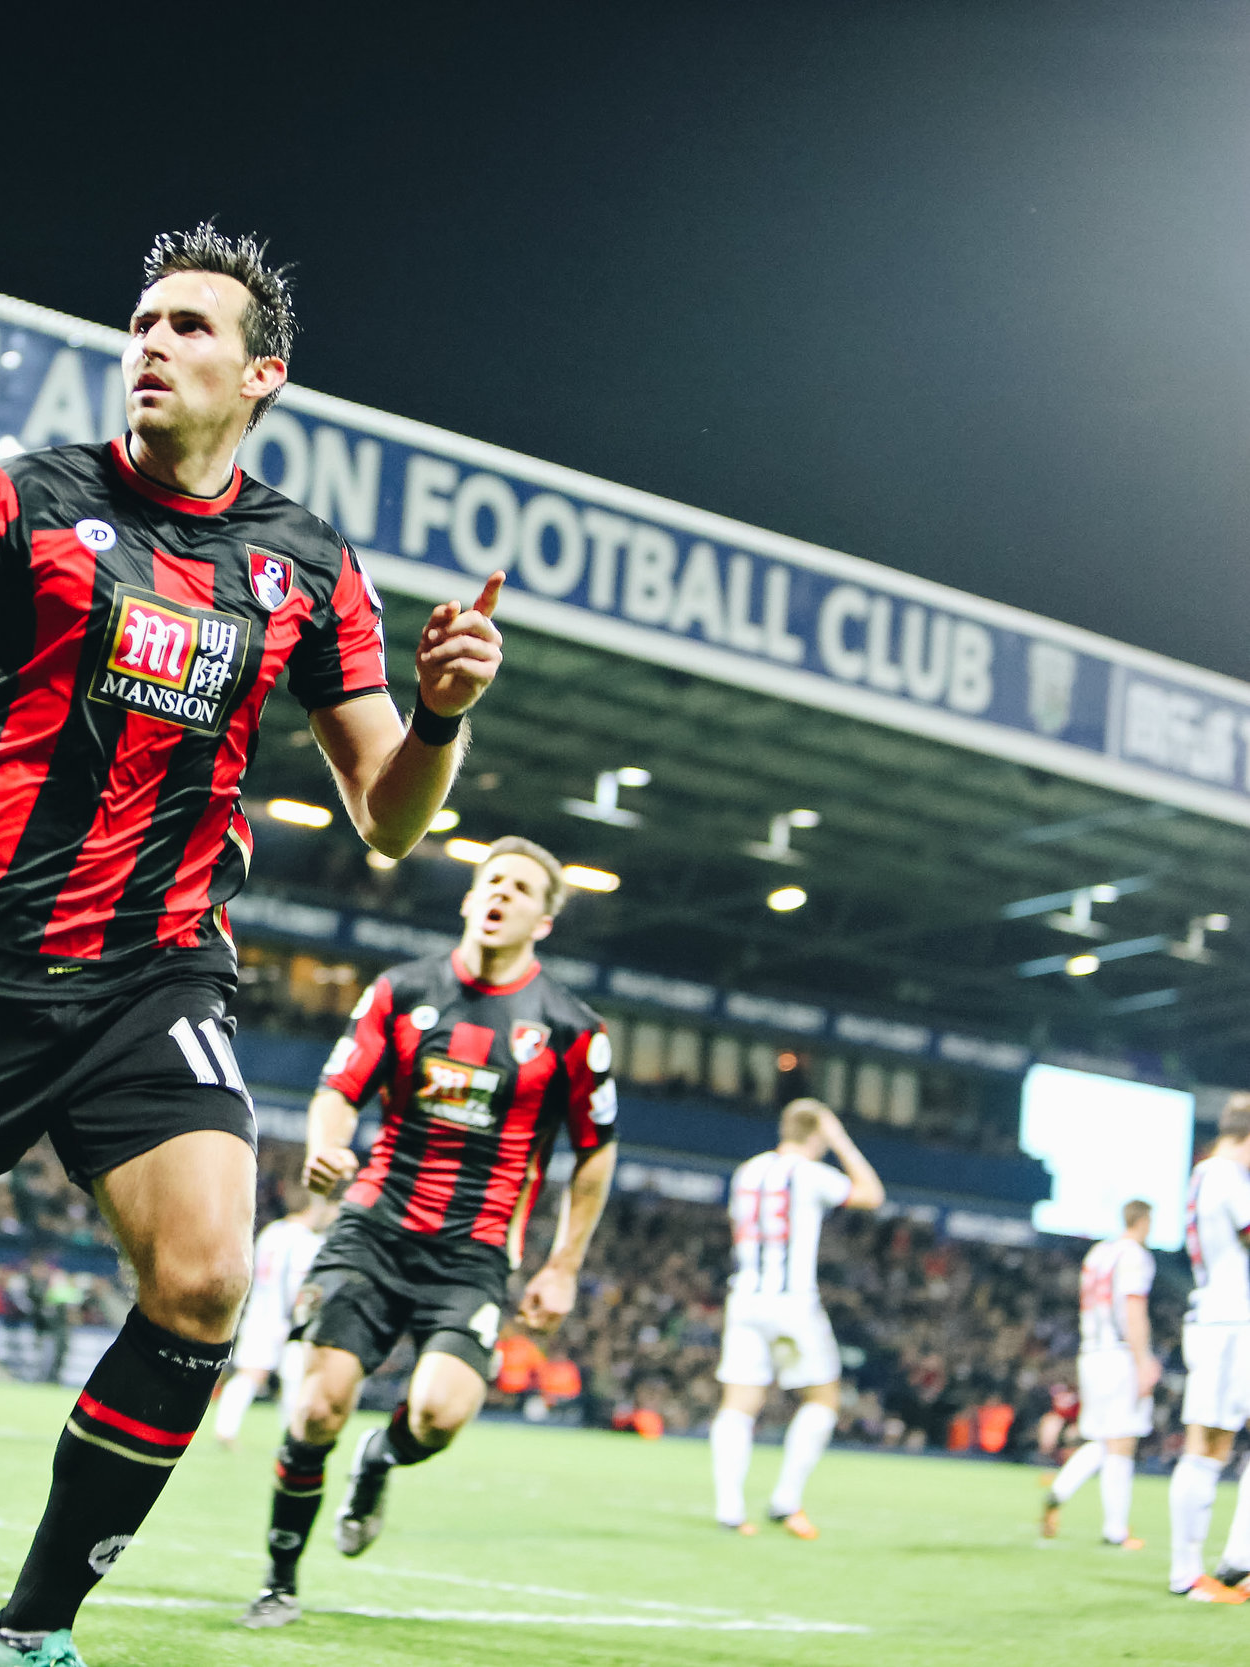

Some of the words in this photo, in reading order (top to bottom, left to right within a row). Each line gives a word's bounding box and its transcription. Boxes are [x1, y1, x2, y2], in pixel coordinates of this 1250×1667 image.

[22, 345, 384, 543] ALON
[400, 453, 805, 665] FOOTBALL
[818, 584, 993, 714] CLUB
[100, 671, 219, 724] MANSION
[168, 1016, 244, 1092] 11
[468, 1303, 501, 1350] 4
